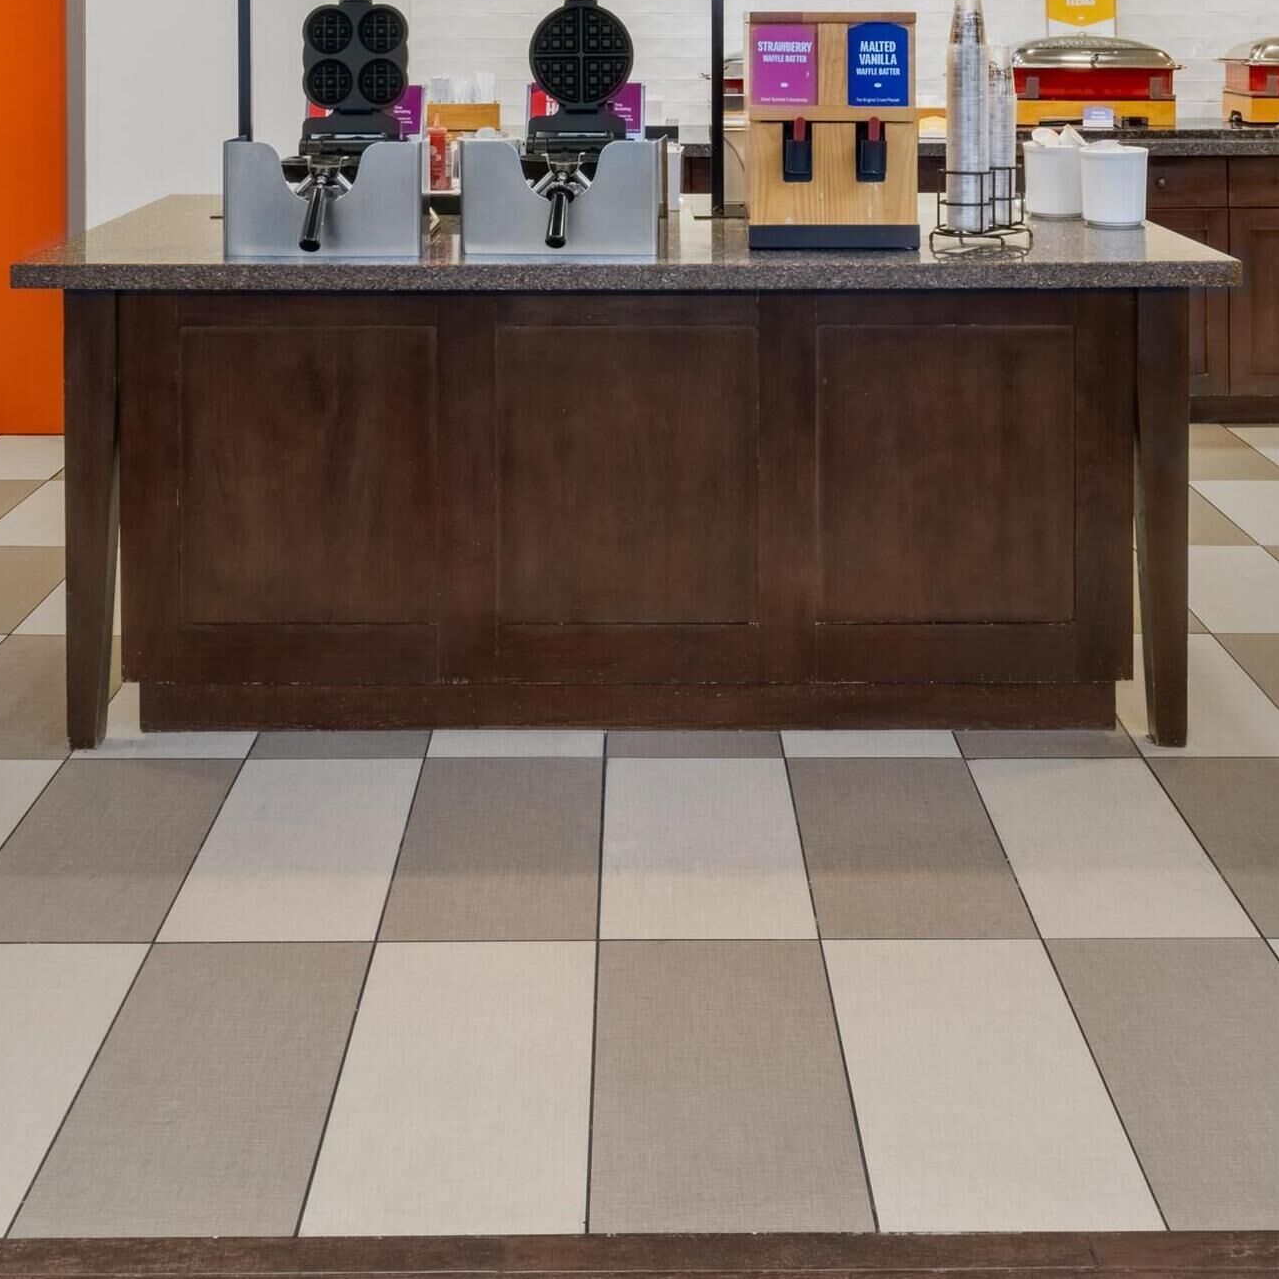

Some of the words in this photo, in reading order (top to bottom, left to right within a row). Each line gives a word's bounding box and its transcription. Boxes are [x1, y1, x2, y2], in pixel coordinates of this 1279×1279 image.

[757, 40, 812, 53] STRAWBERRY
[860, 40, 897, 52] MALTED
[762, 54, 784, 62] WAFFLE
[785, 54, 807, 63] BATTER
[859, 53, 898, 65] VANILLA
[856, 67, 877, 75] WAFFLE
[878, 67, 901, 76] BATTER
